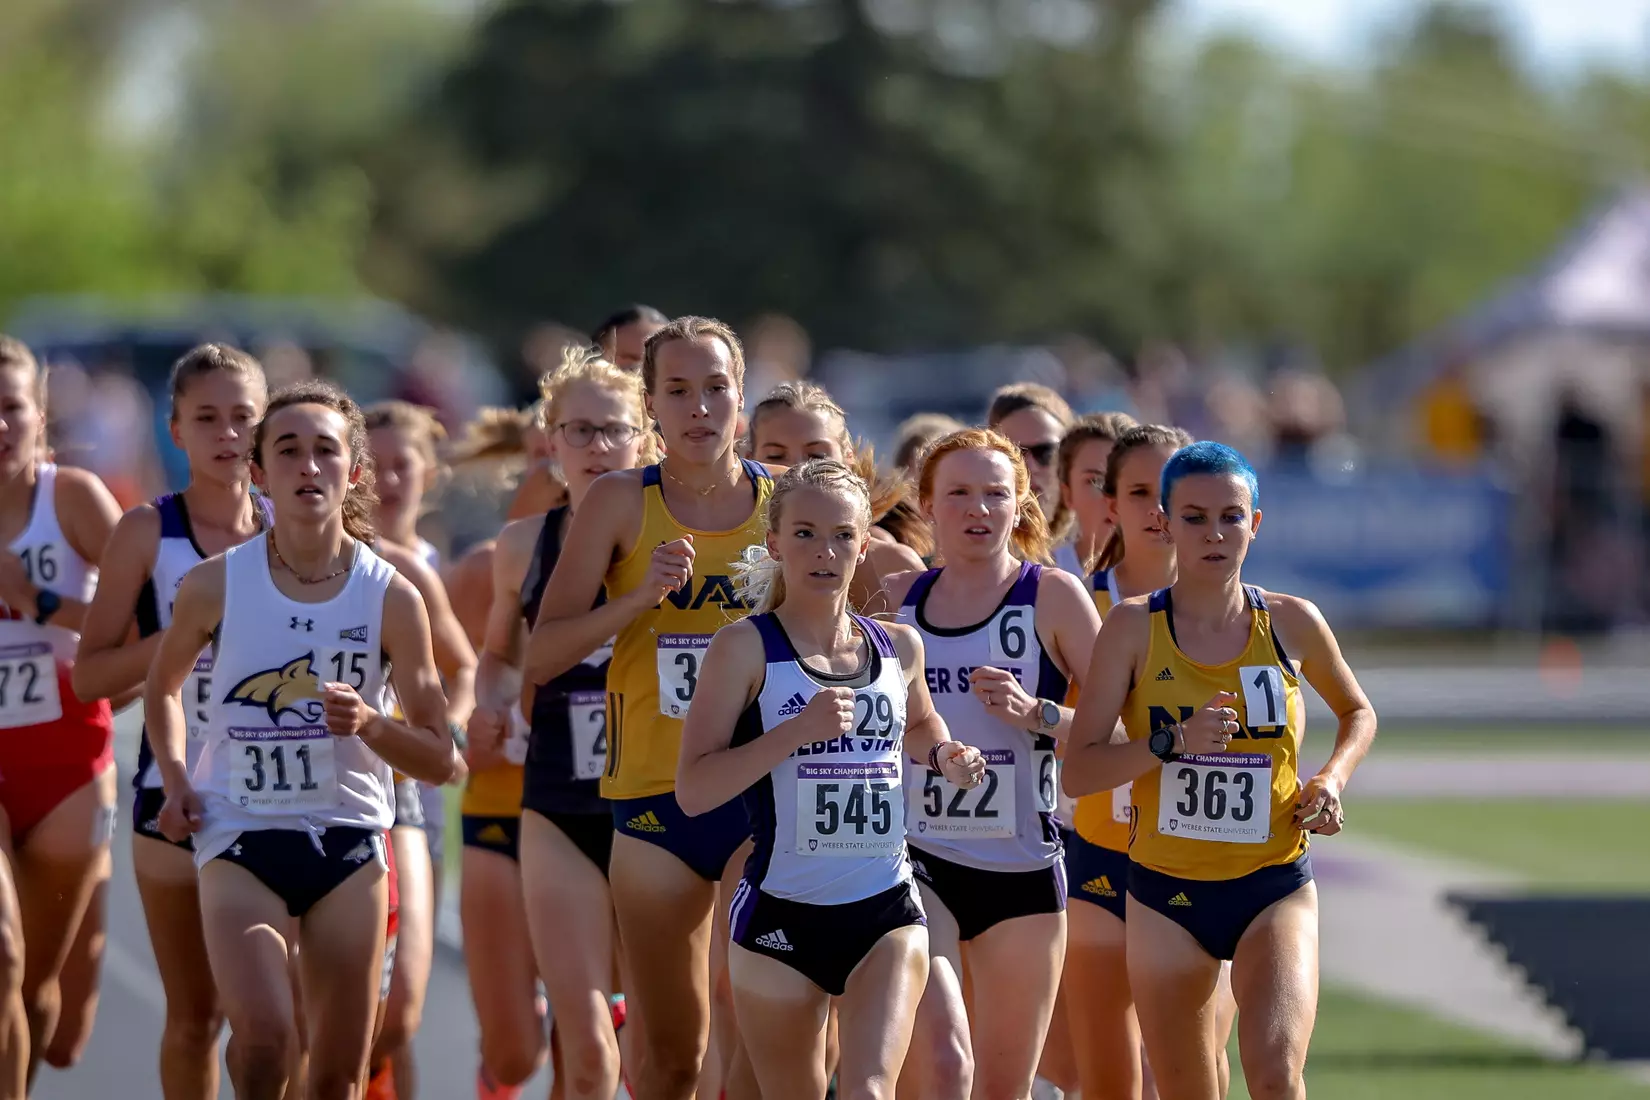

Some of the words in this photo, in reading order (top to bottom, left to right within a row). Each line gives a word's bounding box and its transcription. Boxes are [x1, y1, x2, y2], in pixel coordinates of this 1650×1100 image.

[20, 544, 56, 582] 16
[665, 637, 677, 645] BIG
[678, 637, 690, 645] SKY
[1000, 609, 1027, 659] 6
[330, 651, 368, 692] 15
[674, 652, 697, 702] 3
[855, 693, 894, 738] 29
[1253, 670, 1277, 723] 1
[234, 730, 245, 738] BIG
[245, 730, 257, 738] SKY
[258, 729, 307, 738] CHAMPIONSHIPS
[308, 728, 324, 737] 2021
[588, 710, 607, 756] 2
[244, 744, 319, 792] 311
[991, 754, 1006, 762] 2021
[1183, 753, 1194, 761] SKY
[1195, 754, 1248, 765] CHAMPIONSHIPS
[1249, 757, 1263, 765] 2021
[923, 769, 999, 818] 522
[1039, 753, 1055, 810] 6
[1176, 767, 1254, 822] 363
[626, 821, 666, 832] adidas
[815, 783, 891, 836] 545
[1181, 822, 1201, 831] WEBER
[1203, 826, 1222, 834] STATE
[1223, 827, 1258, 835] UNIVERSITY
[865, 841, 895, 849] UNIVERSITY
[1081, 883, 1117, 897] adidas
[1167, 899, 1192, 907] adidas
[755, 937, 794, 952] adidas
